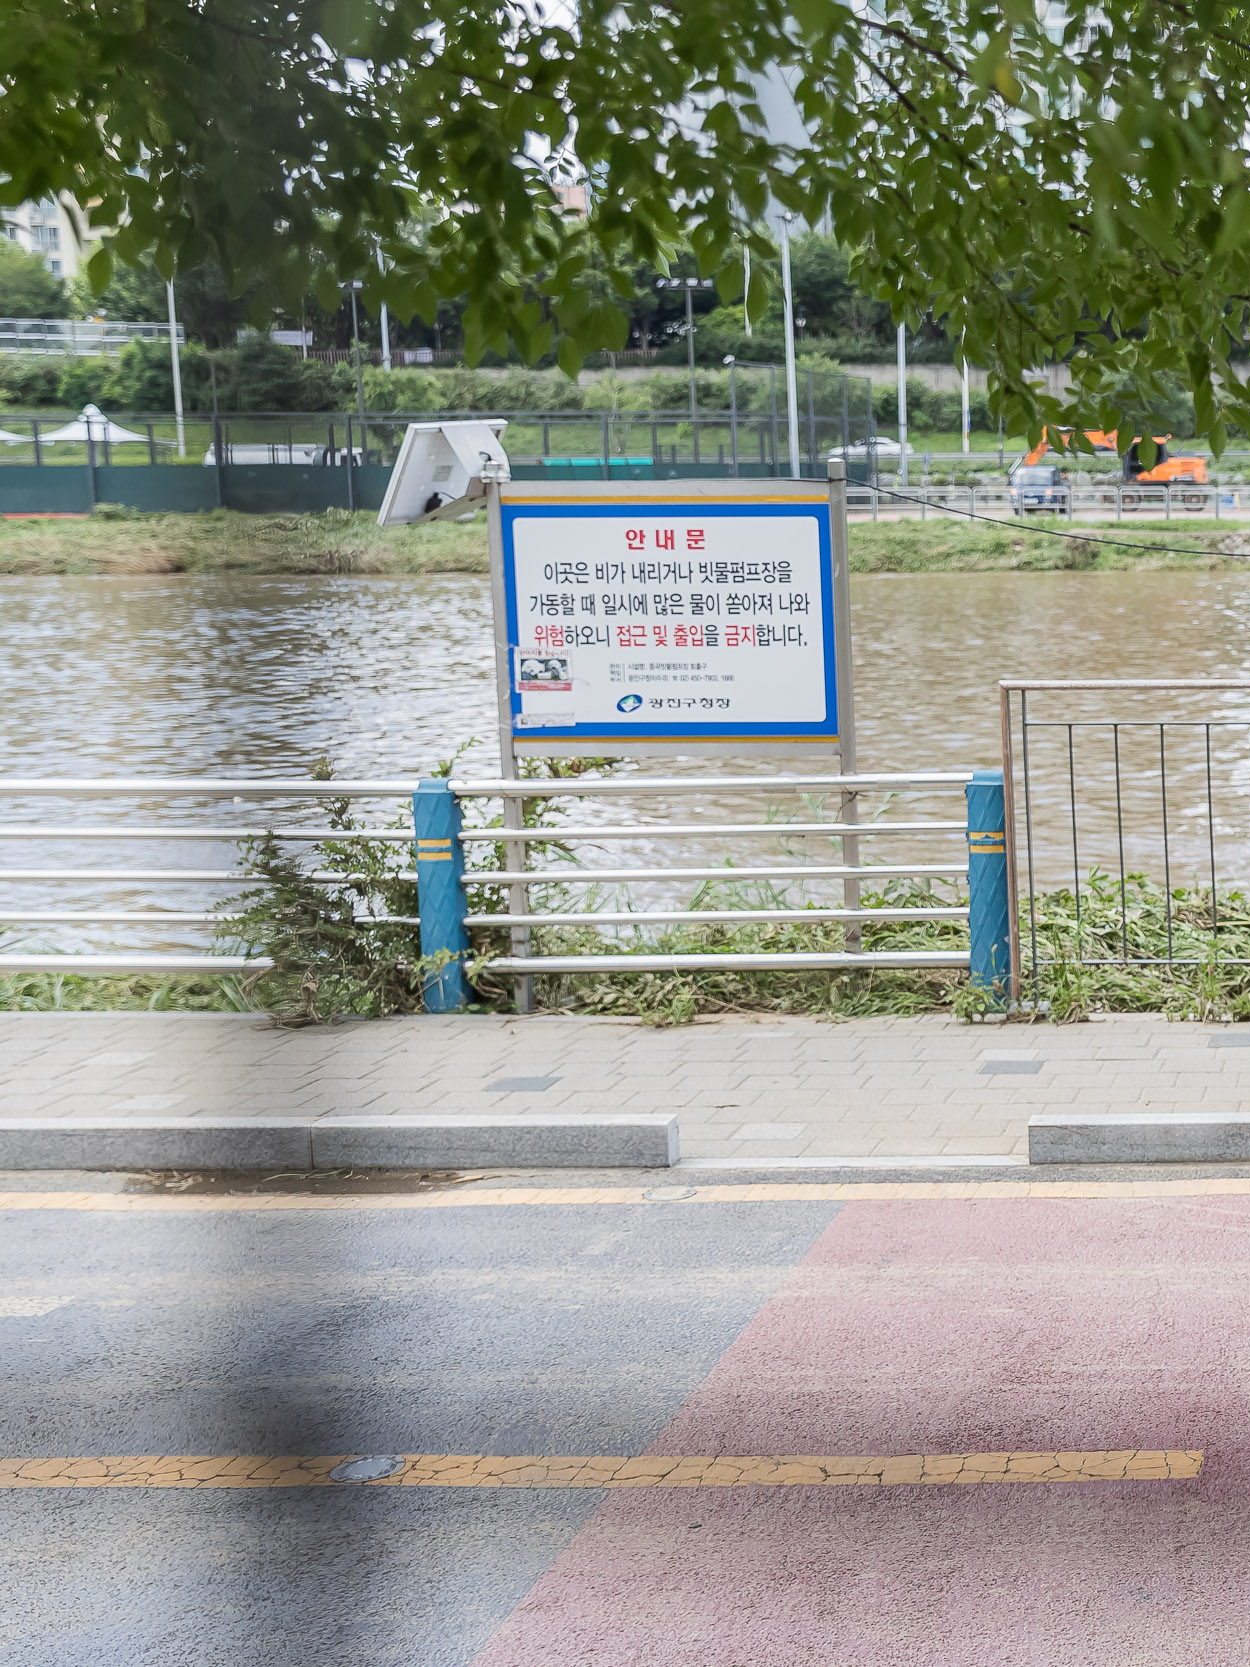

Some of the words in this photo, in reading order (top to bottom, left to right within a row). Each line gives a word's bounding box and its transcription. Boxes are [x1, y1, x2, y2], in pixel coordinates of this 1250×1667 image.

[545, 562, 589, 584] 이곳은
[596, 562, 625, 584] 비가
[632, 562, 693, 584] 내리거나
[699, 561, 792, 583] 빗물펌프장을
[530, 594, 575, 616] 가동할
[581, 594, 595, 615] 때
[602, 594, 648, 615] 일시에
[654, 594, 684, 616] 많은
[690, 593, 720, 615] 물이
[726, 593, 772, 615] 쏟아져
[779, 593, 810, 615] 나와
[535, 625, 609, 647] 위험하오니
[617, 626, 647, 646] 접근
[653, 625, 667, 646] 및
[674, 625, 719, 646] 출입을
[725, 625, 807, 646] 금지합니다.
[649, 698, 730, 708] 광진구청장
